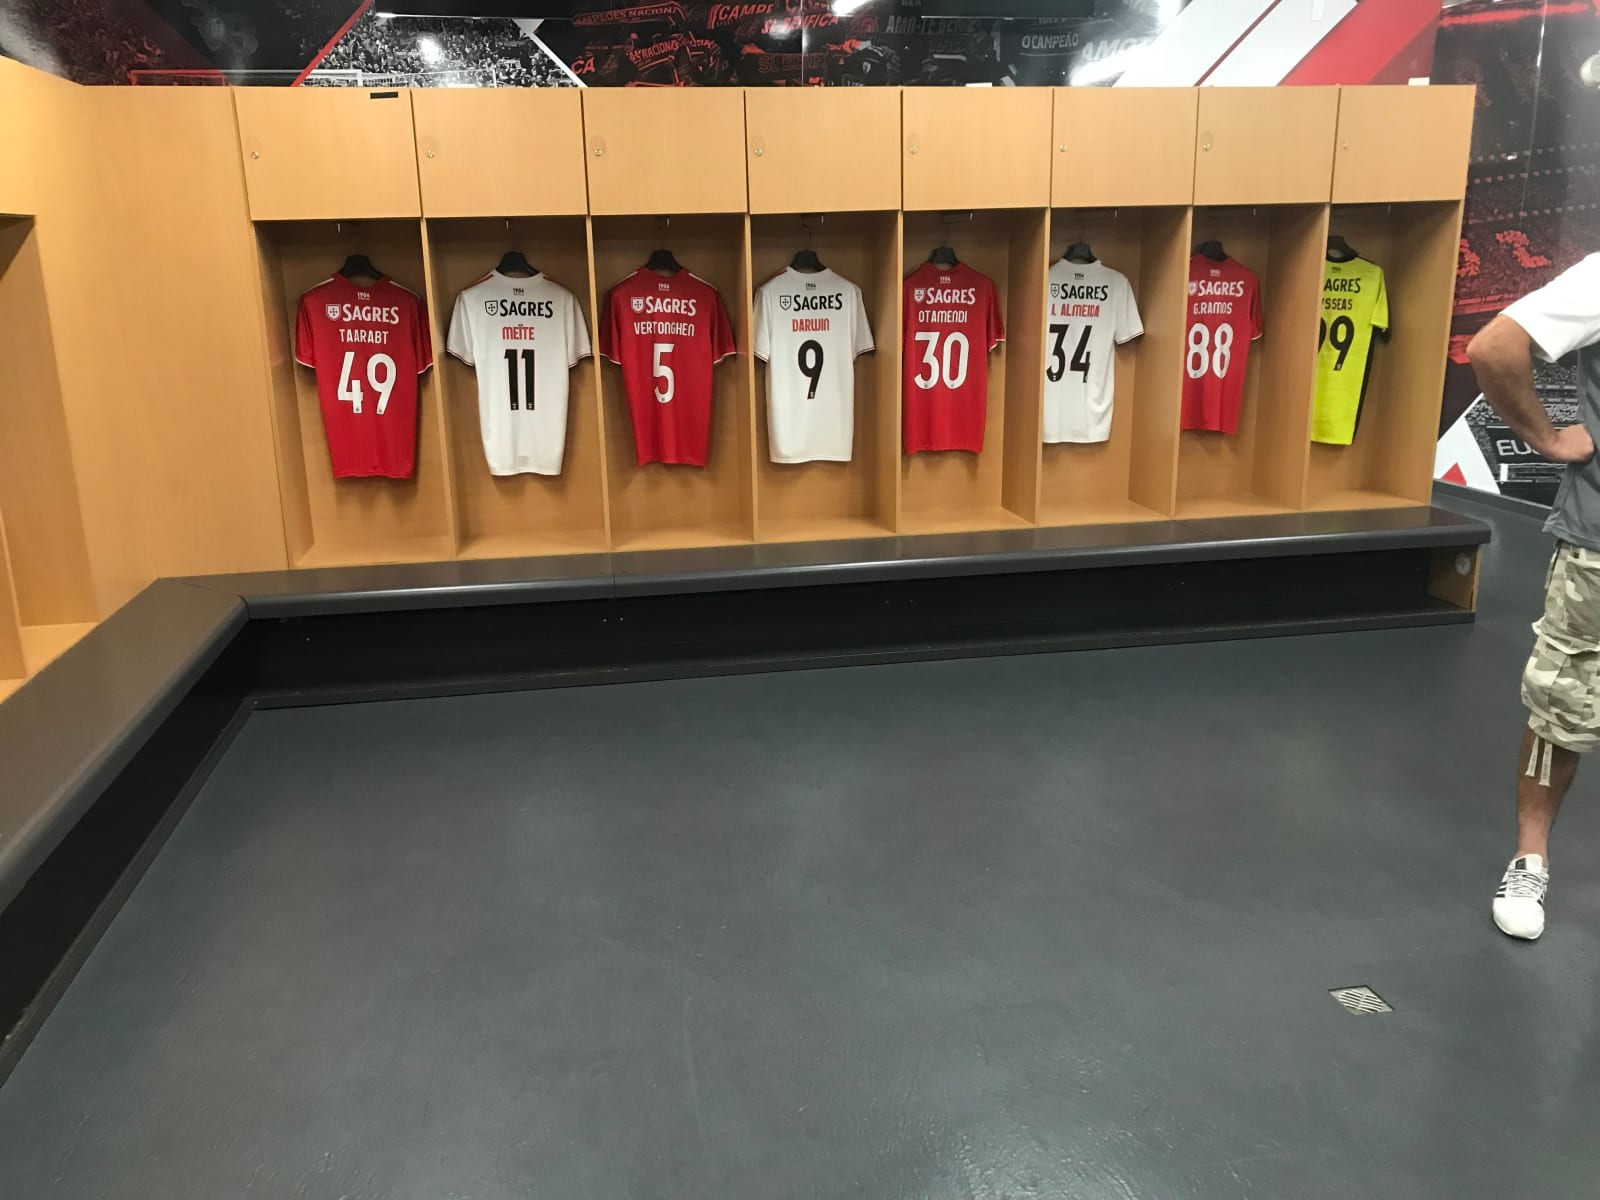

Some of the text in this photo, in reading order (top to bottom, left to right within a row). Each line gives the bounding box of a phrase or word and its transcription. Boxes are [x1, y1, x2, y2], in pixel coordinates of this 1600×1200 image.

[1060, 283, 1109, 302] SAGRES
[1198, 280, 1244, 298] SAGRES
[1323, 277, 1361, 294] AGRES
[645, 295, 697, 317] SAGRES
[793, 292, 844, 312] SAGRES
[925, 287, 977, 306] SAGRES
[1321, 297, 1353, 311] SSEAS
[342, 303, 400, 325] SAGRES
[499, 299, 554, 319] SAGRES
[918, 310, 968, 324] OTAMENDI
[1060, 303, 1100, 318] ALMEIDA
[633, 320, 695, 337] VERTONGHEN
[791, 317, 830, 333] DARWIN
[338, 328, 389, 345] TAARABT
[913, 331, 970, 390] 30
[1046, 323, 1093, 384] 34
[1186, 322, 1234, 380] 88
[652, 342, 675, 404] 5
[797, 339, 824, 400] 9
[337, 351, 397, 415] 49
[504, 348, 536, 411] 11
[1496, 439, 1541, 456] EU
